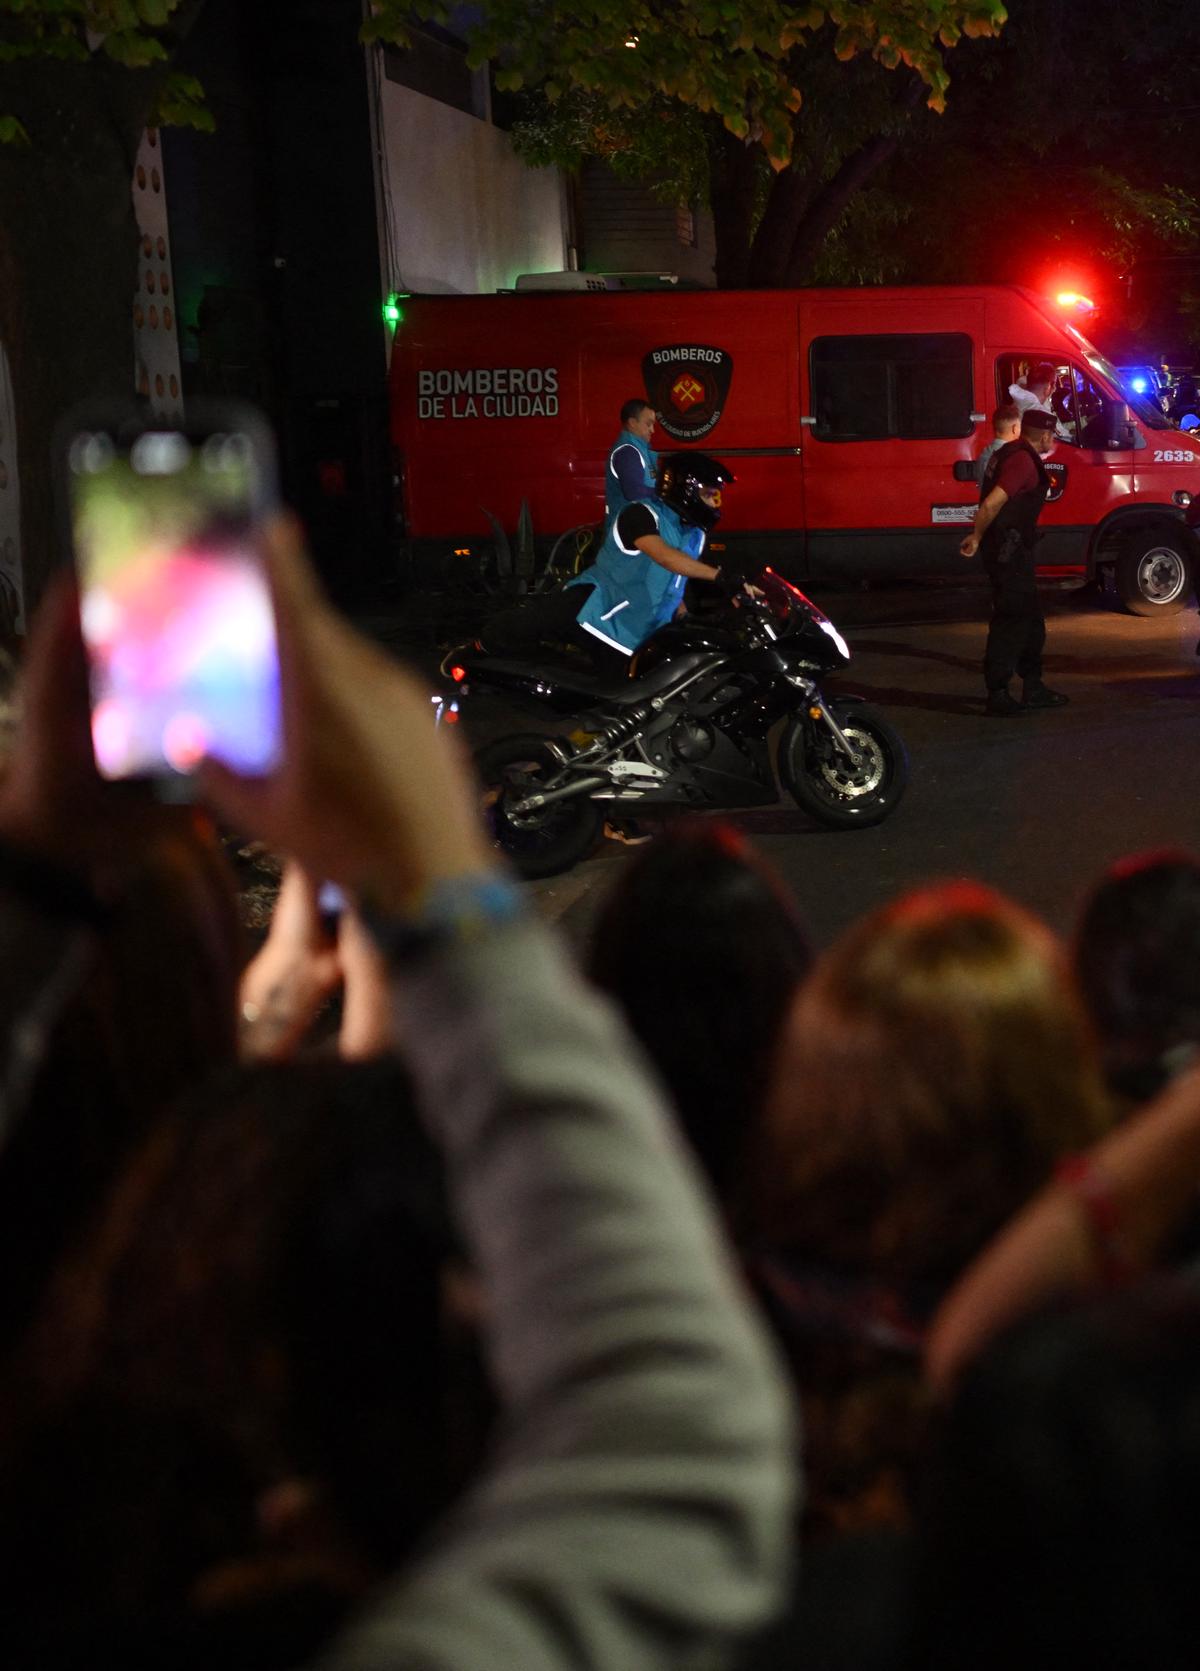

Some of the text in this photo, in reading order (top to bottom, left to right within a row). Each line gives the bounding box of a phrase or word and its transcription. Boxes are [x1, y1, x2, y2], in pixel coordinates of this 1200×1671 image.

[652, 347, 723, 365] BOMBEROS
[417, 368, 559, 395] BOMBEROS
[418, 395, 559, 419] DE LA CIUDAD
[1153, 450, 1195, 463] 2633
